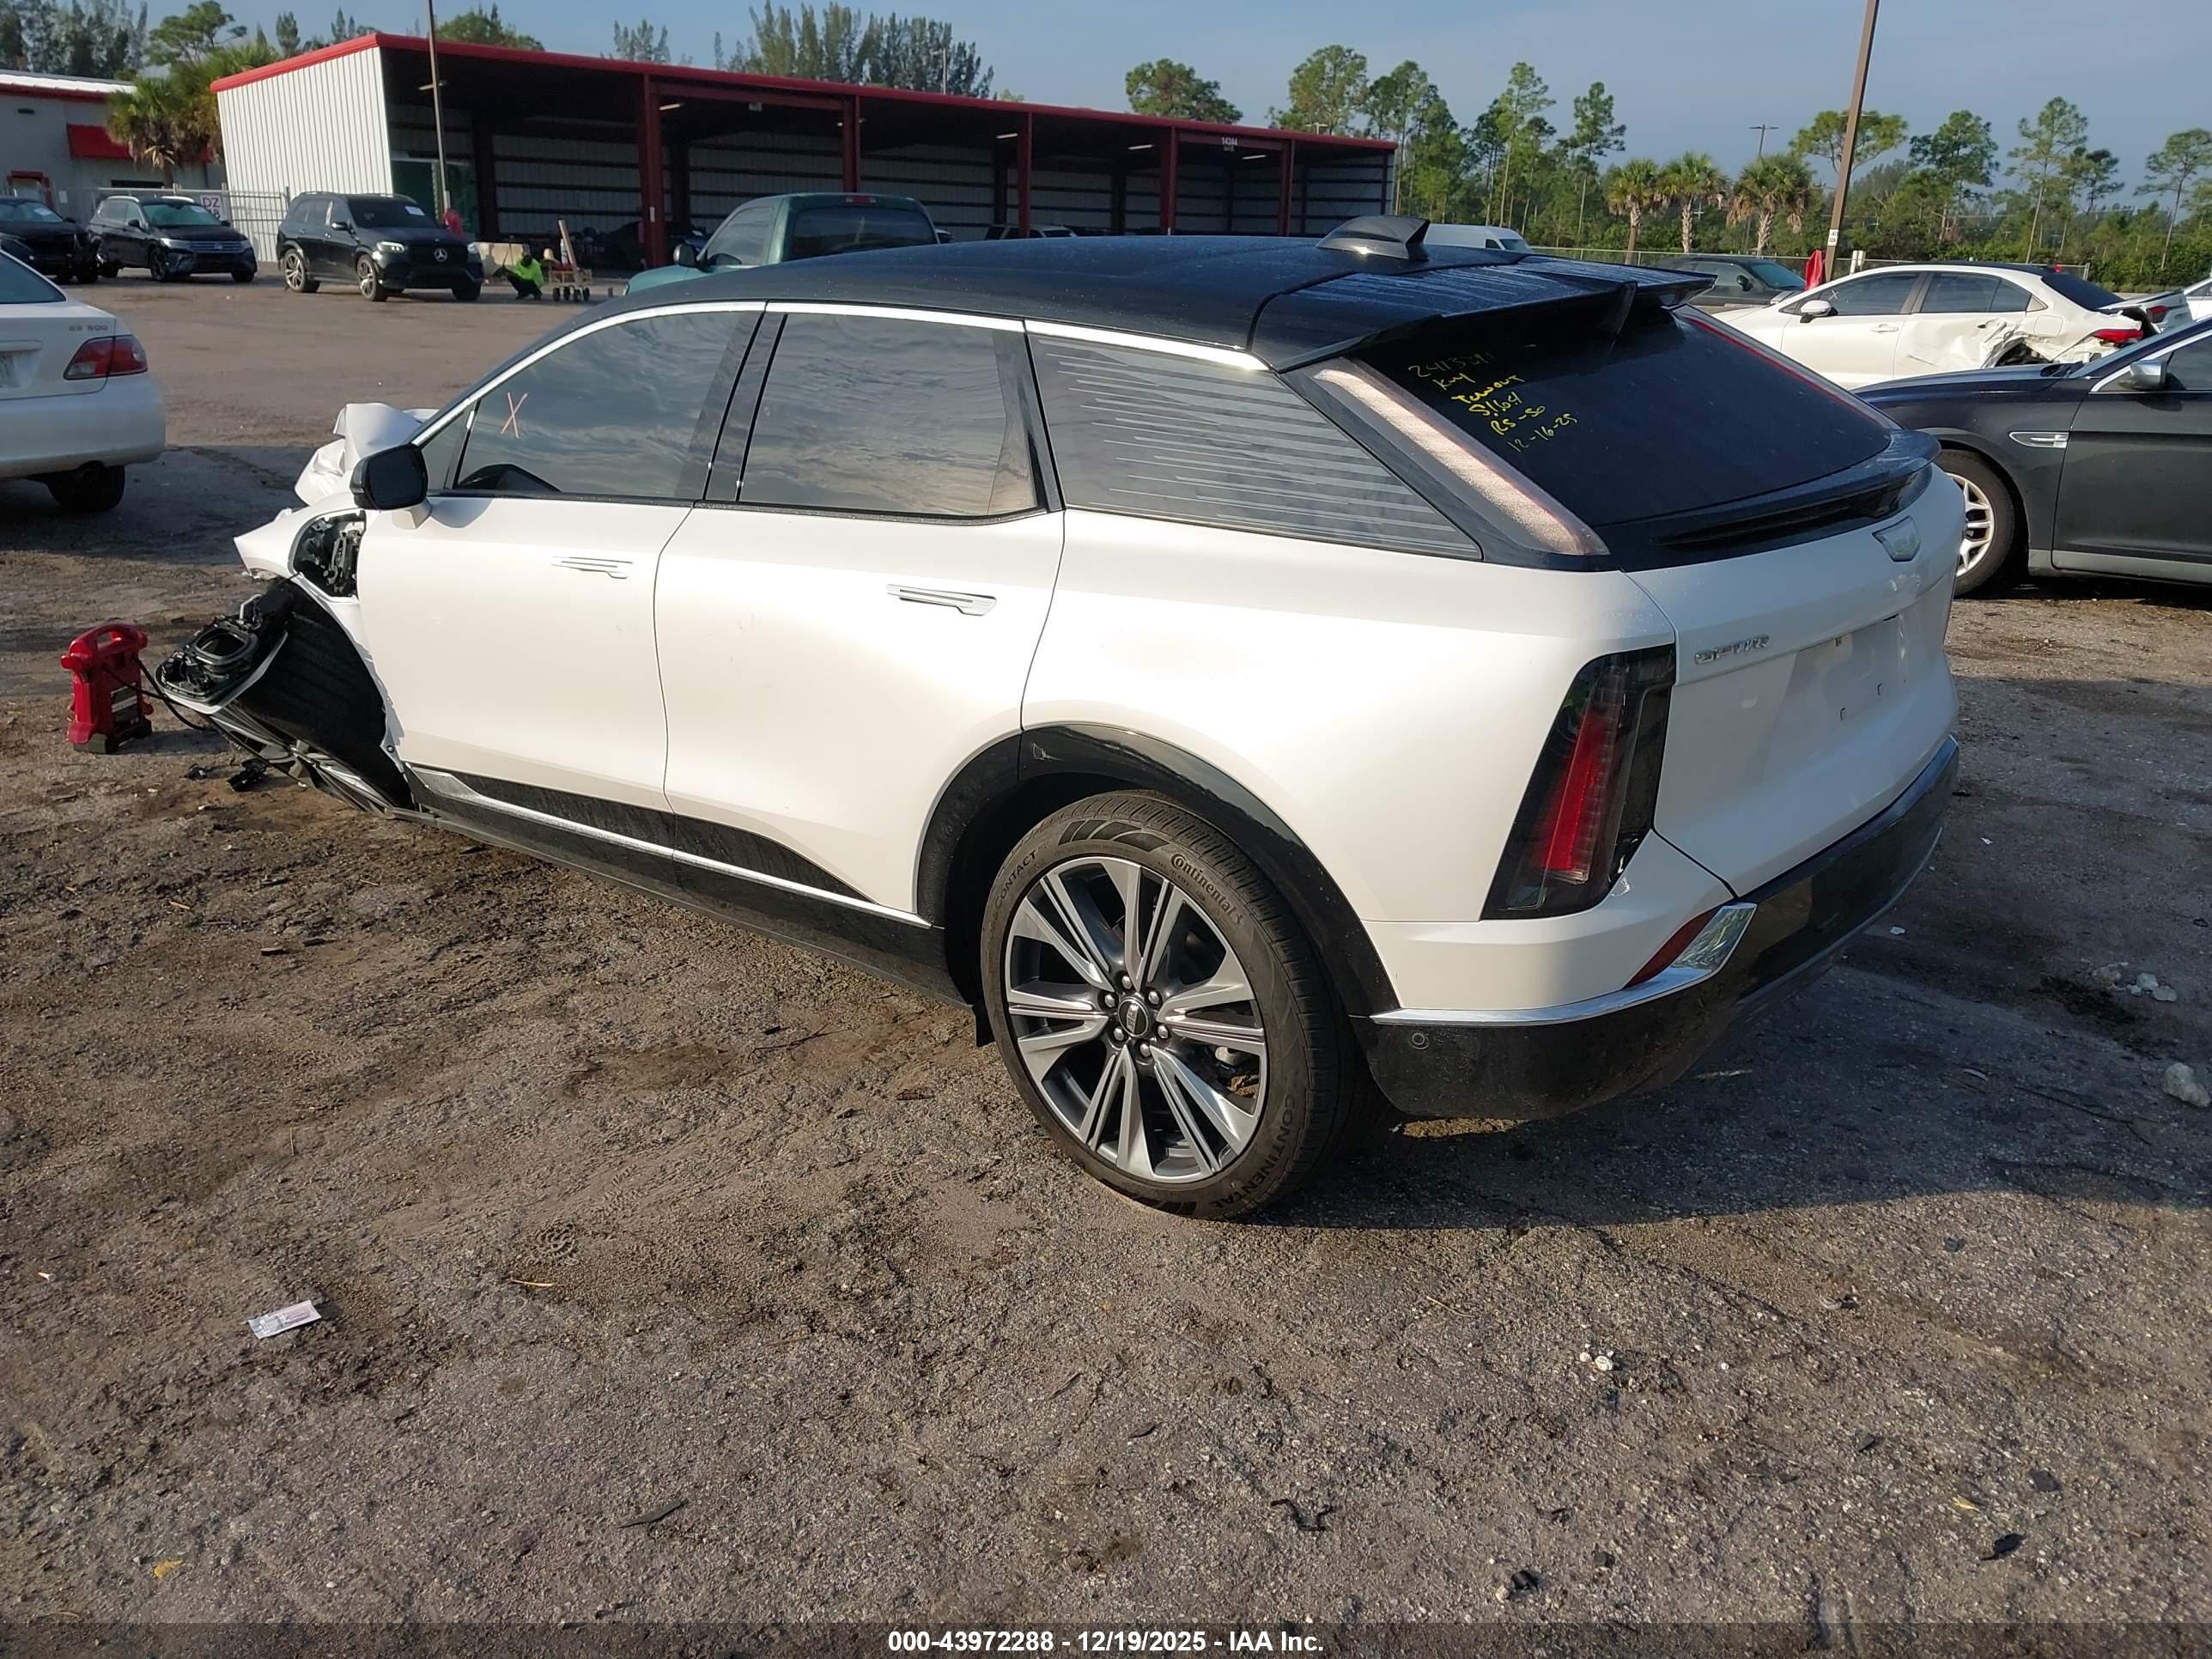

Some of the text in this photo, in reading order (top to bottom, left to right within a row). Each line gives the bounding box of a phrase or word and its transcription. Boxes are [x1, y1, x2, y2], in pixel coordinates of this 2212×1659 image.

[202, 198, 221, 208] DZ
[1170, 853, 1237, 918] Continental
[1209, 1093, 1296, 1208] CONTINENTAL
